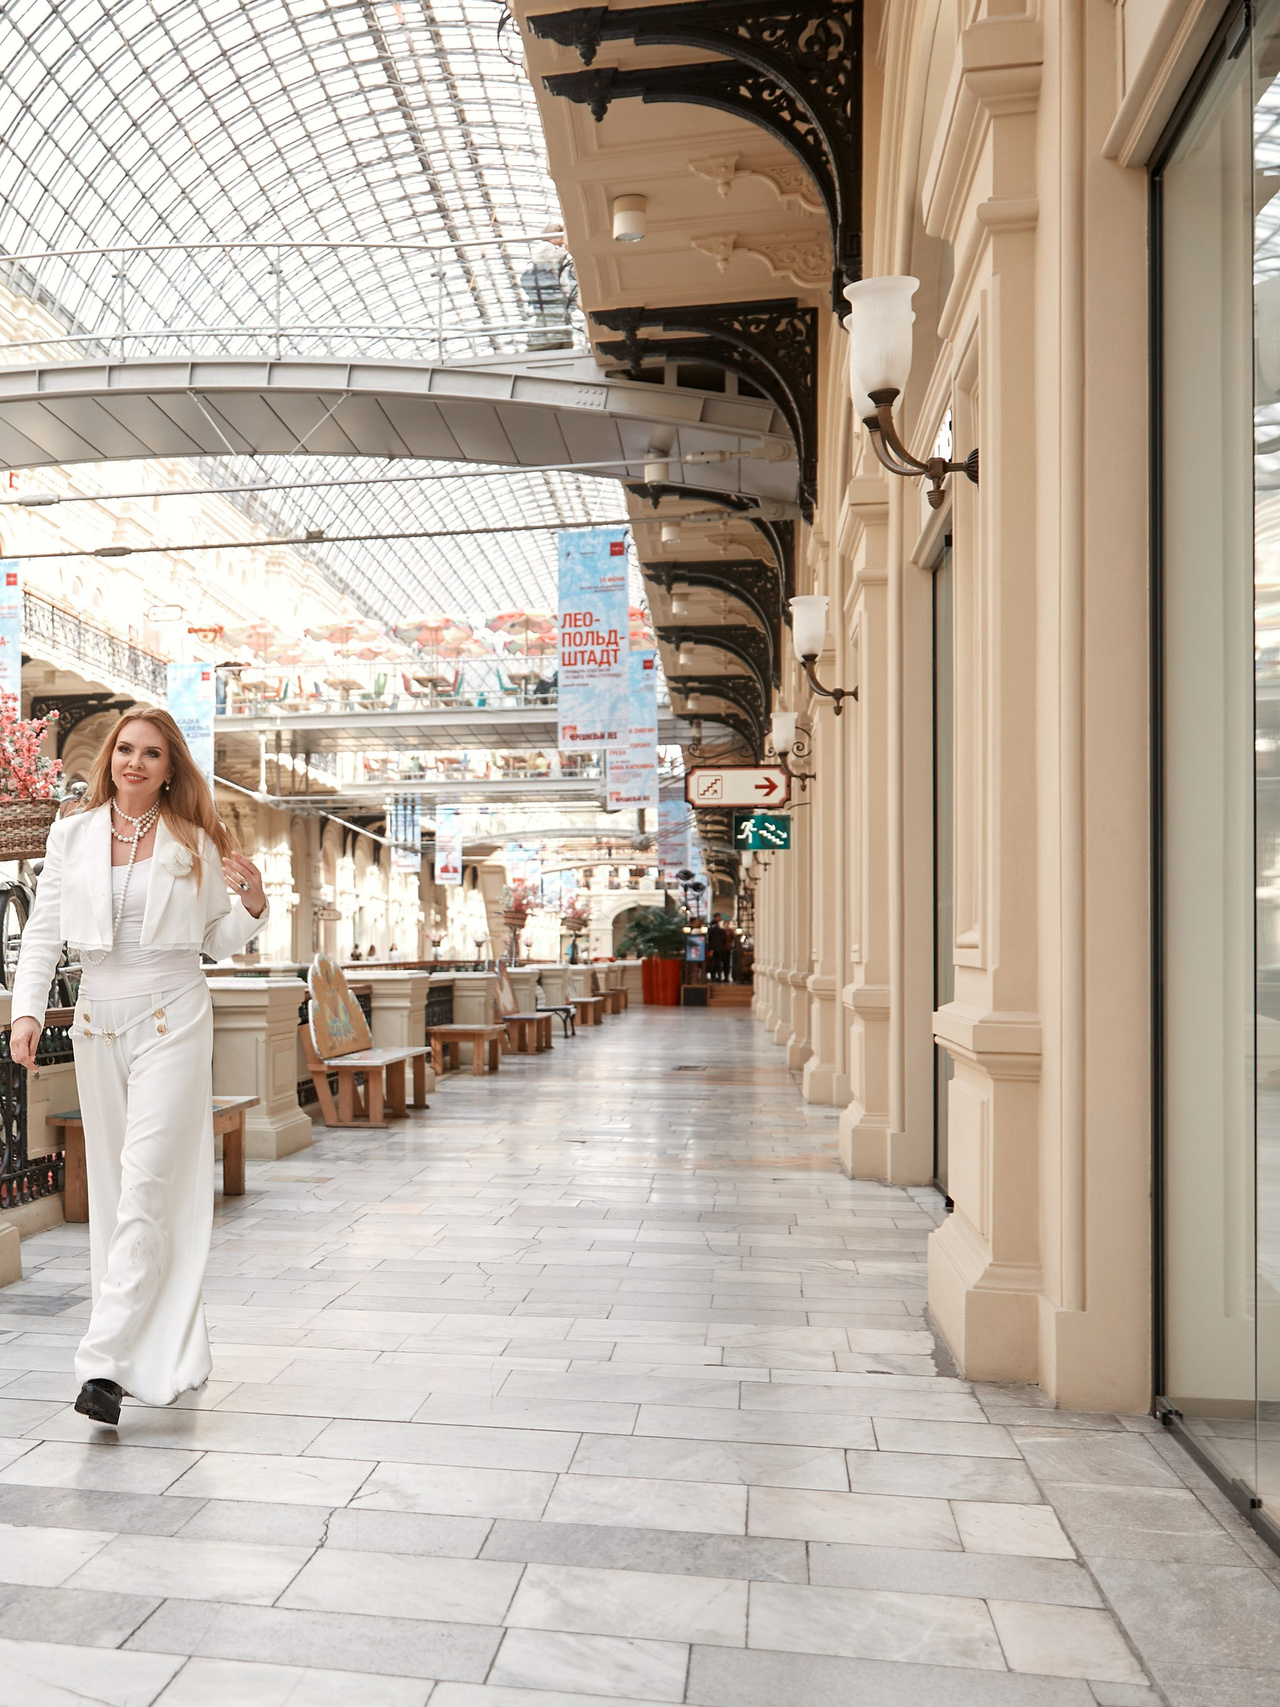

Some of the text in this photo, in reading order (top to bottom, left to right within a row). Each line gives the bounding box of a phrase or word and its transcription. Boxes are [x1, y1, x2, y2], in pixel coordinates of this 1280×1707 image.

[561, 611, 601, 628] ЛЕО-
[562, 629, 626, 647] ПОЛЬД-
[562, 648, 621, 667] ШТАДТ
